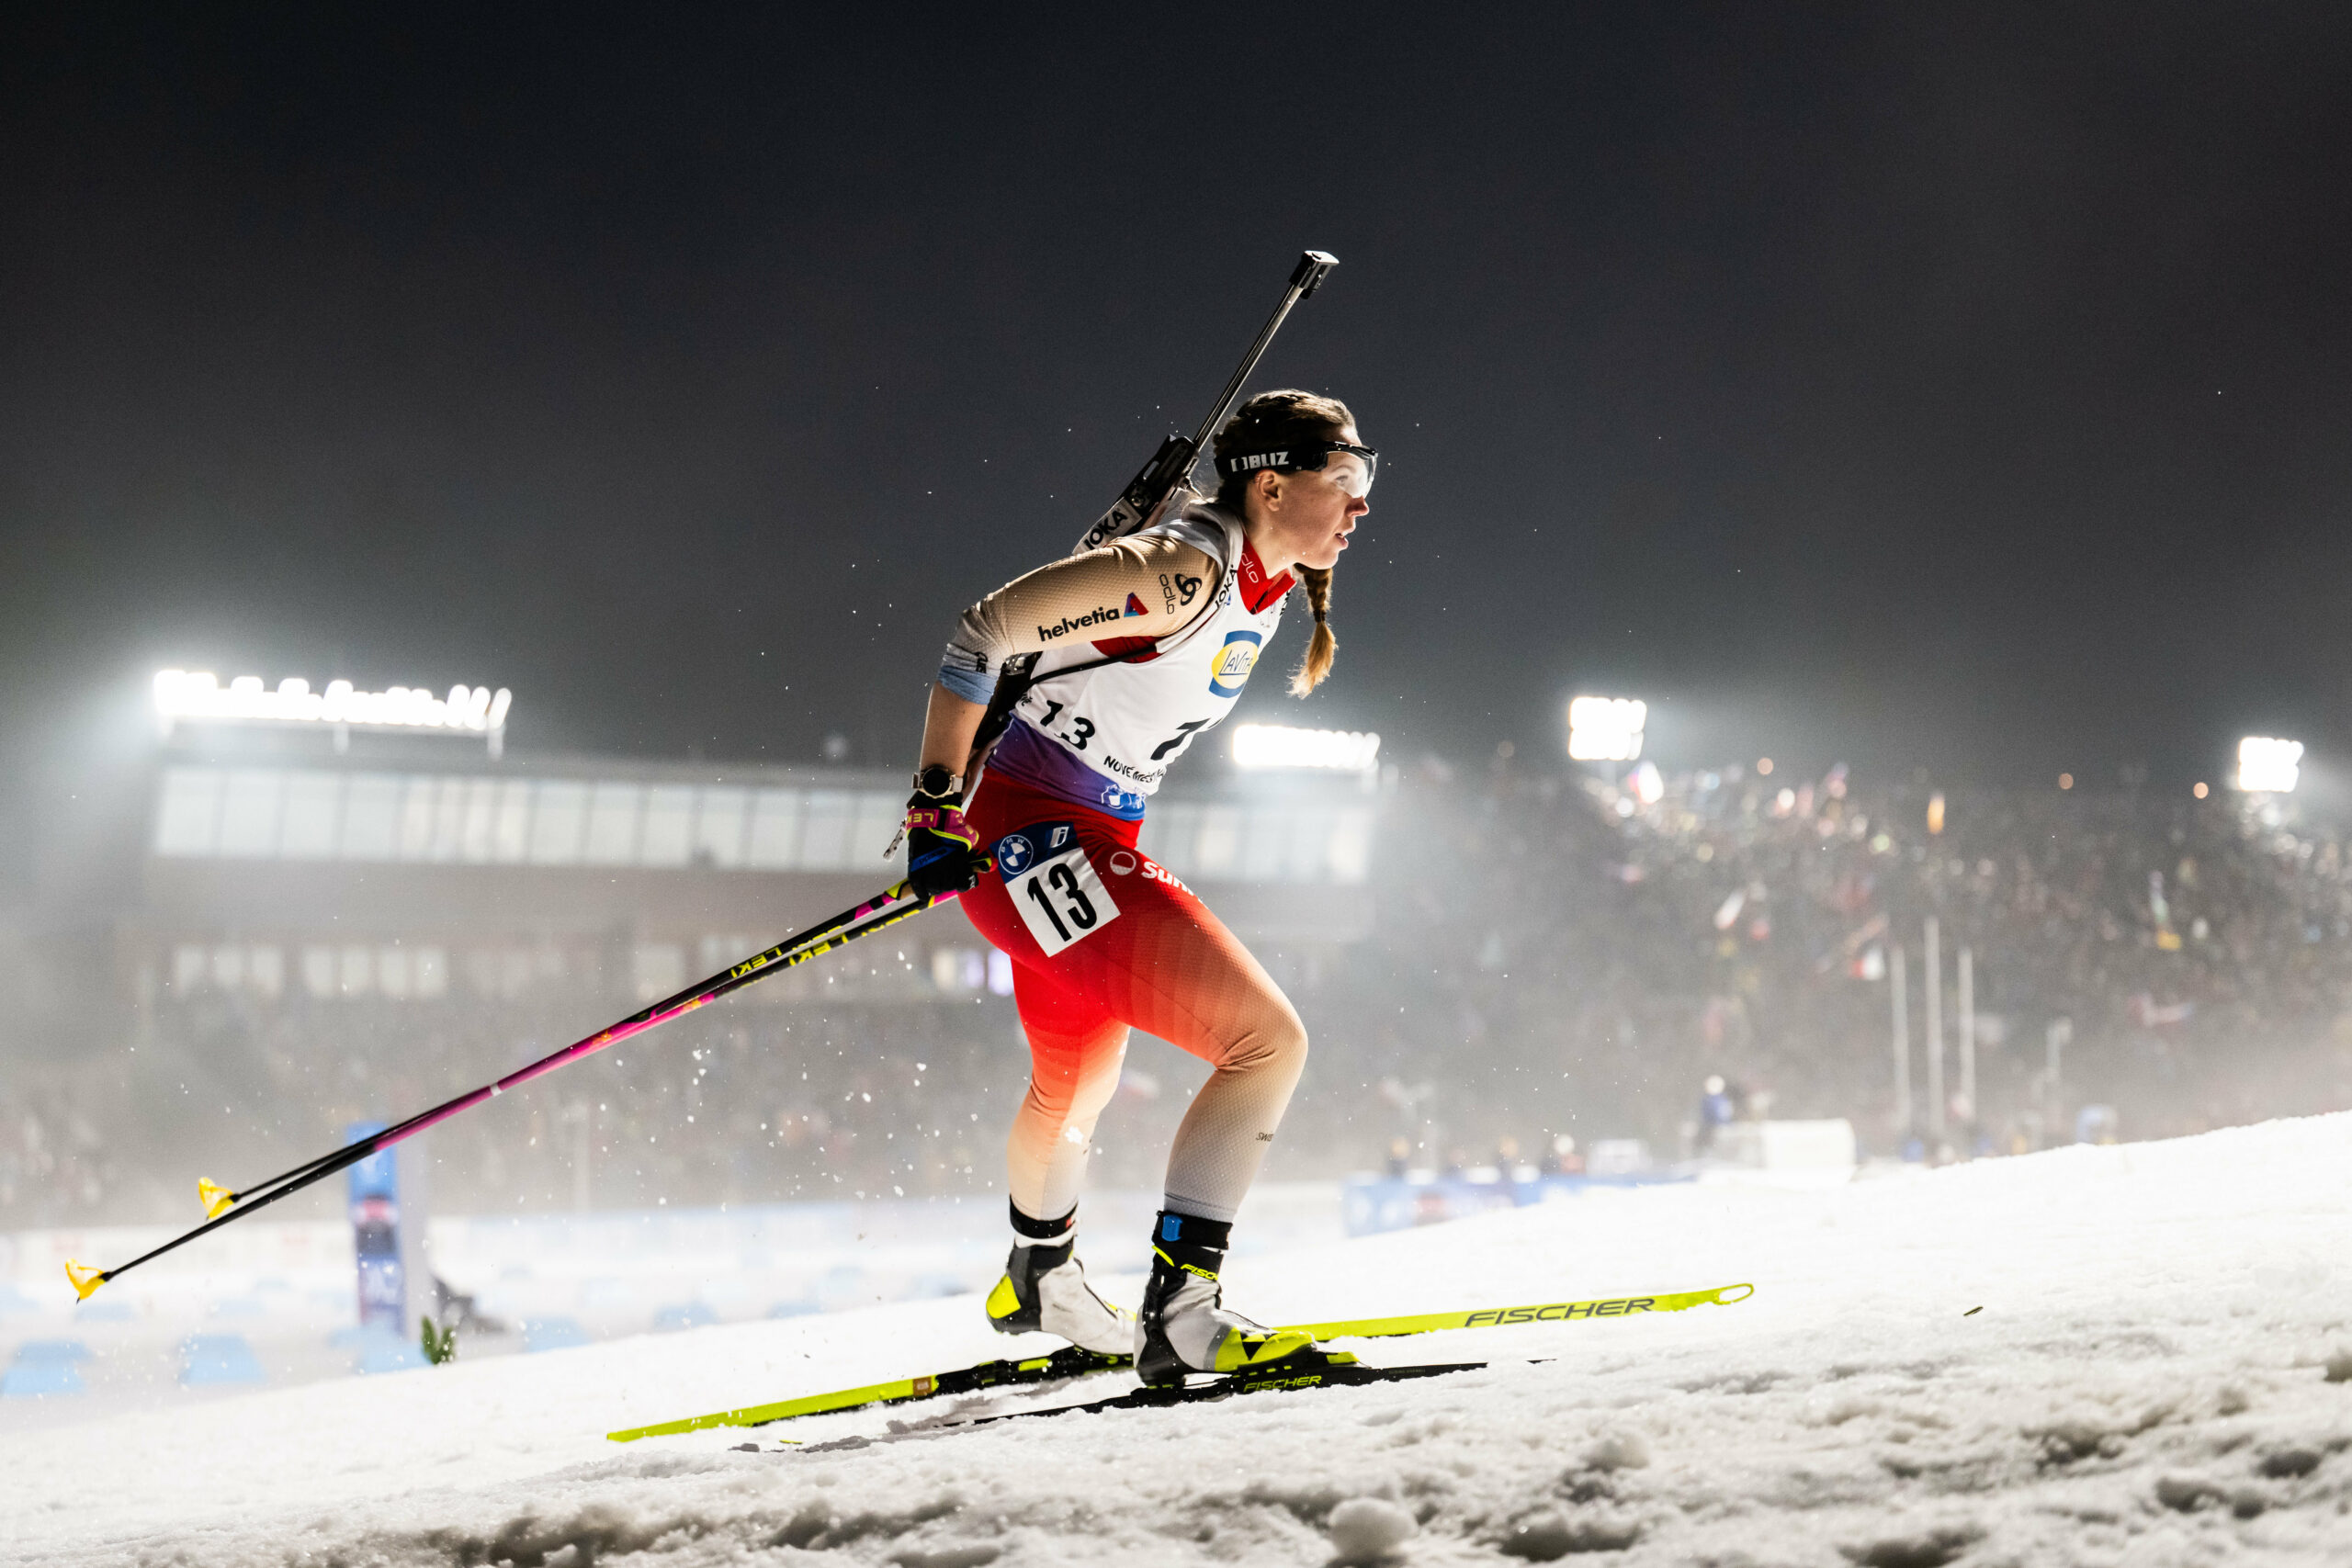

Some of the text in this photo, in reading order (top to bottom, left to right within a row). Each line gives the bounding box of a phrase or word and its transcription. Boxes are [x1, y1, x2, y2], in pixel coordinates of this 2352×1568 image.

[1159, 574, 1176, 615] odlo
[1037, 606, 1120, 642] helvetia
[1039, 699, 1096, 750] 13
[1027, 863, 1097, 942] 13
[731, 946, 782, 978] LEKI
[789, 933, 849, 966] LEKI
[1464, 1298, 1656, 1327] FISCHER
[1243, 1375, 1322, 1393] FISCHER
